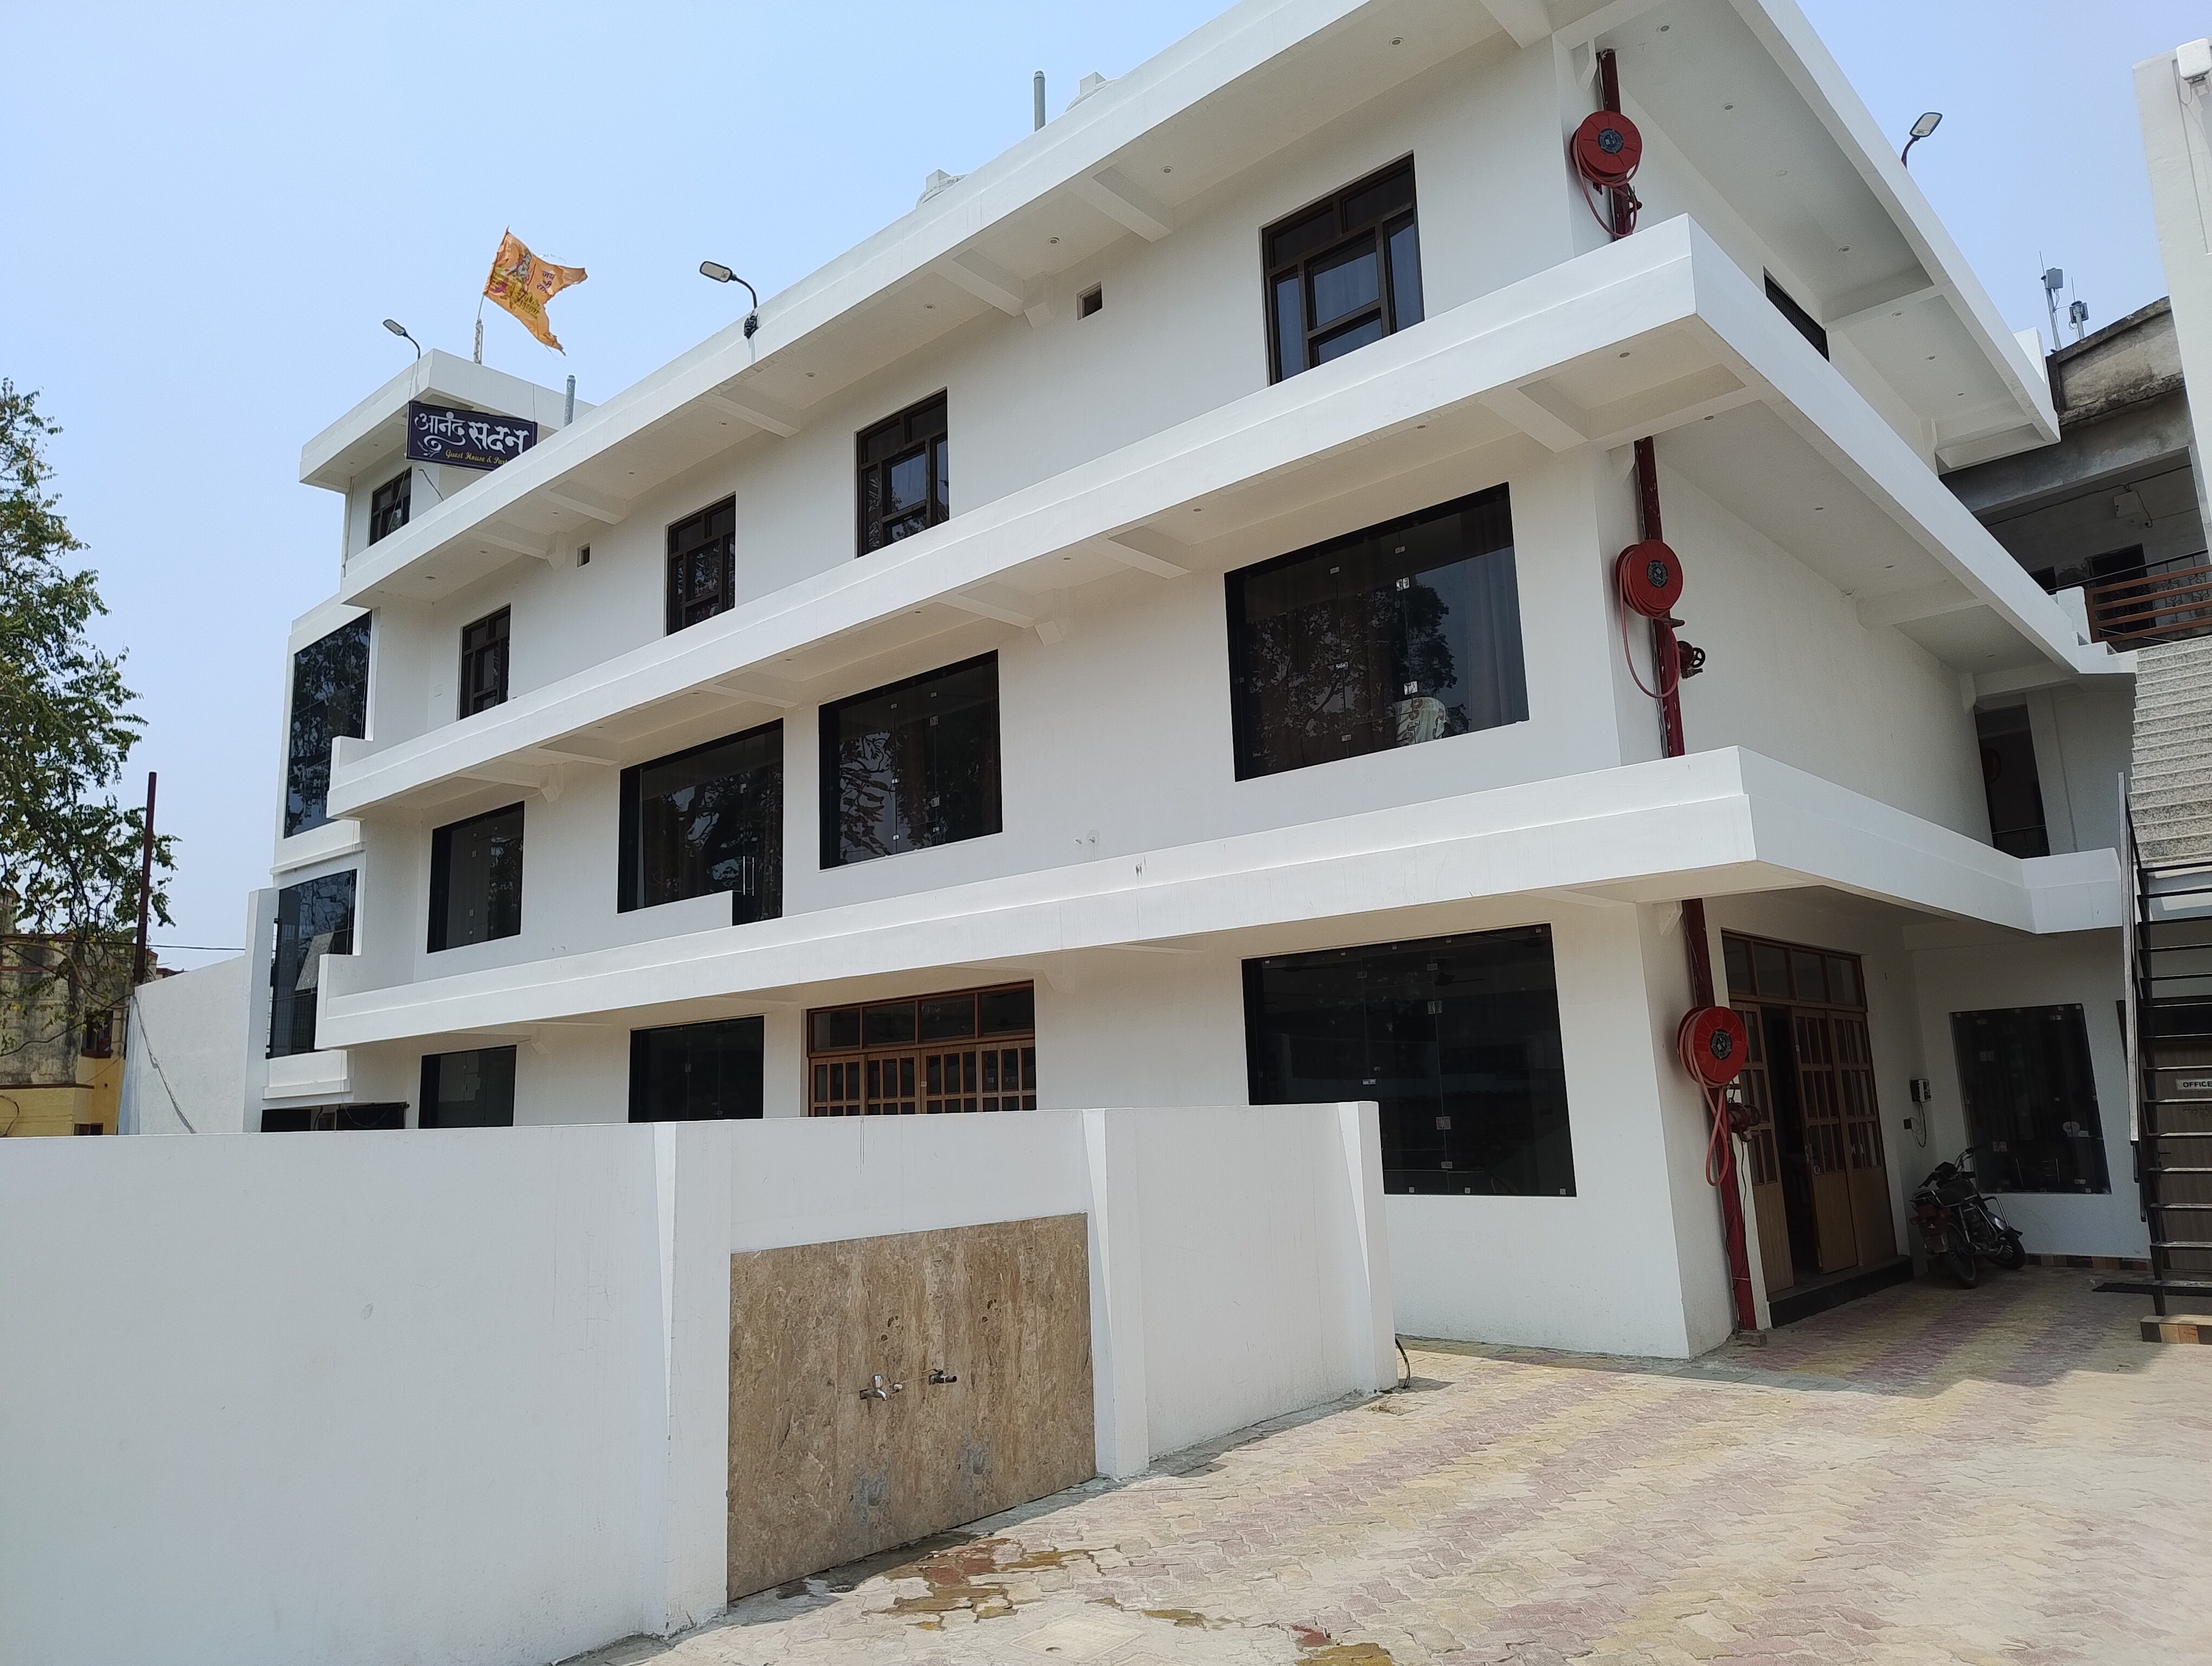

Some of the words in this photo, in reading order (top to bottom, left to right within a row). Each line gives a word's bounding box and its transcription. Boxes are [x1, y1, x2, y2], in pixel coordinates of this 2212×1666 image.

[414, 411, 466, 445] आनंद
[467, 421, 529, 453] सदन
[445, 450, 463, 459] Guest
[465, 452, 485, 462] House
